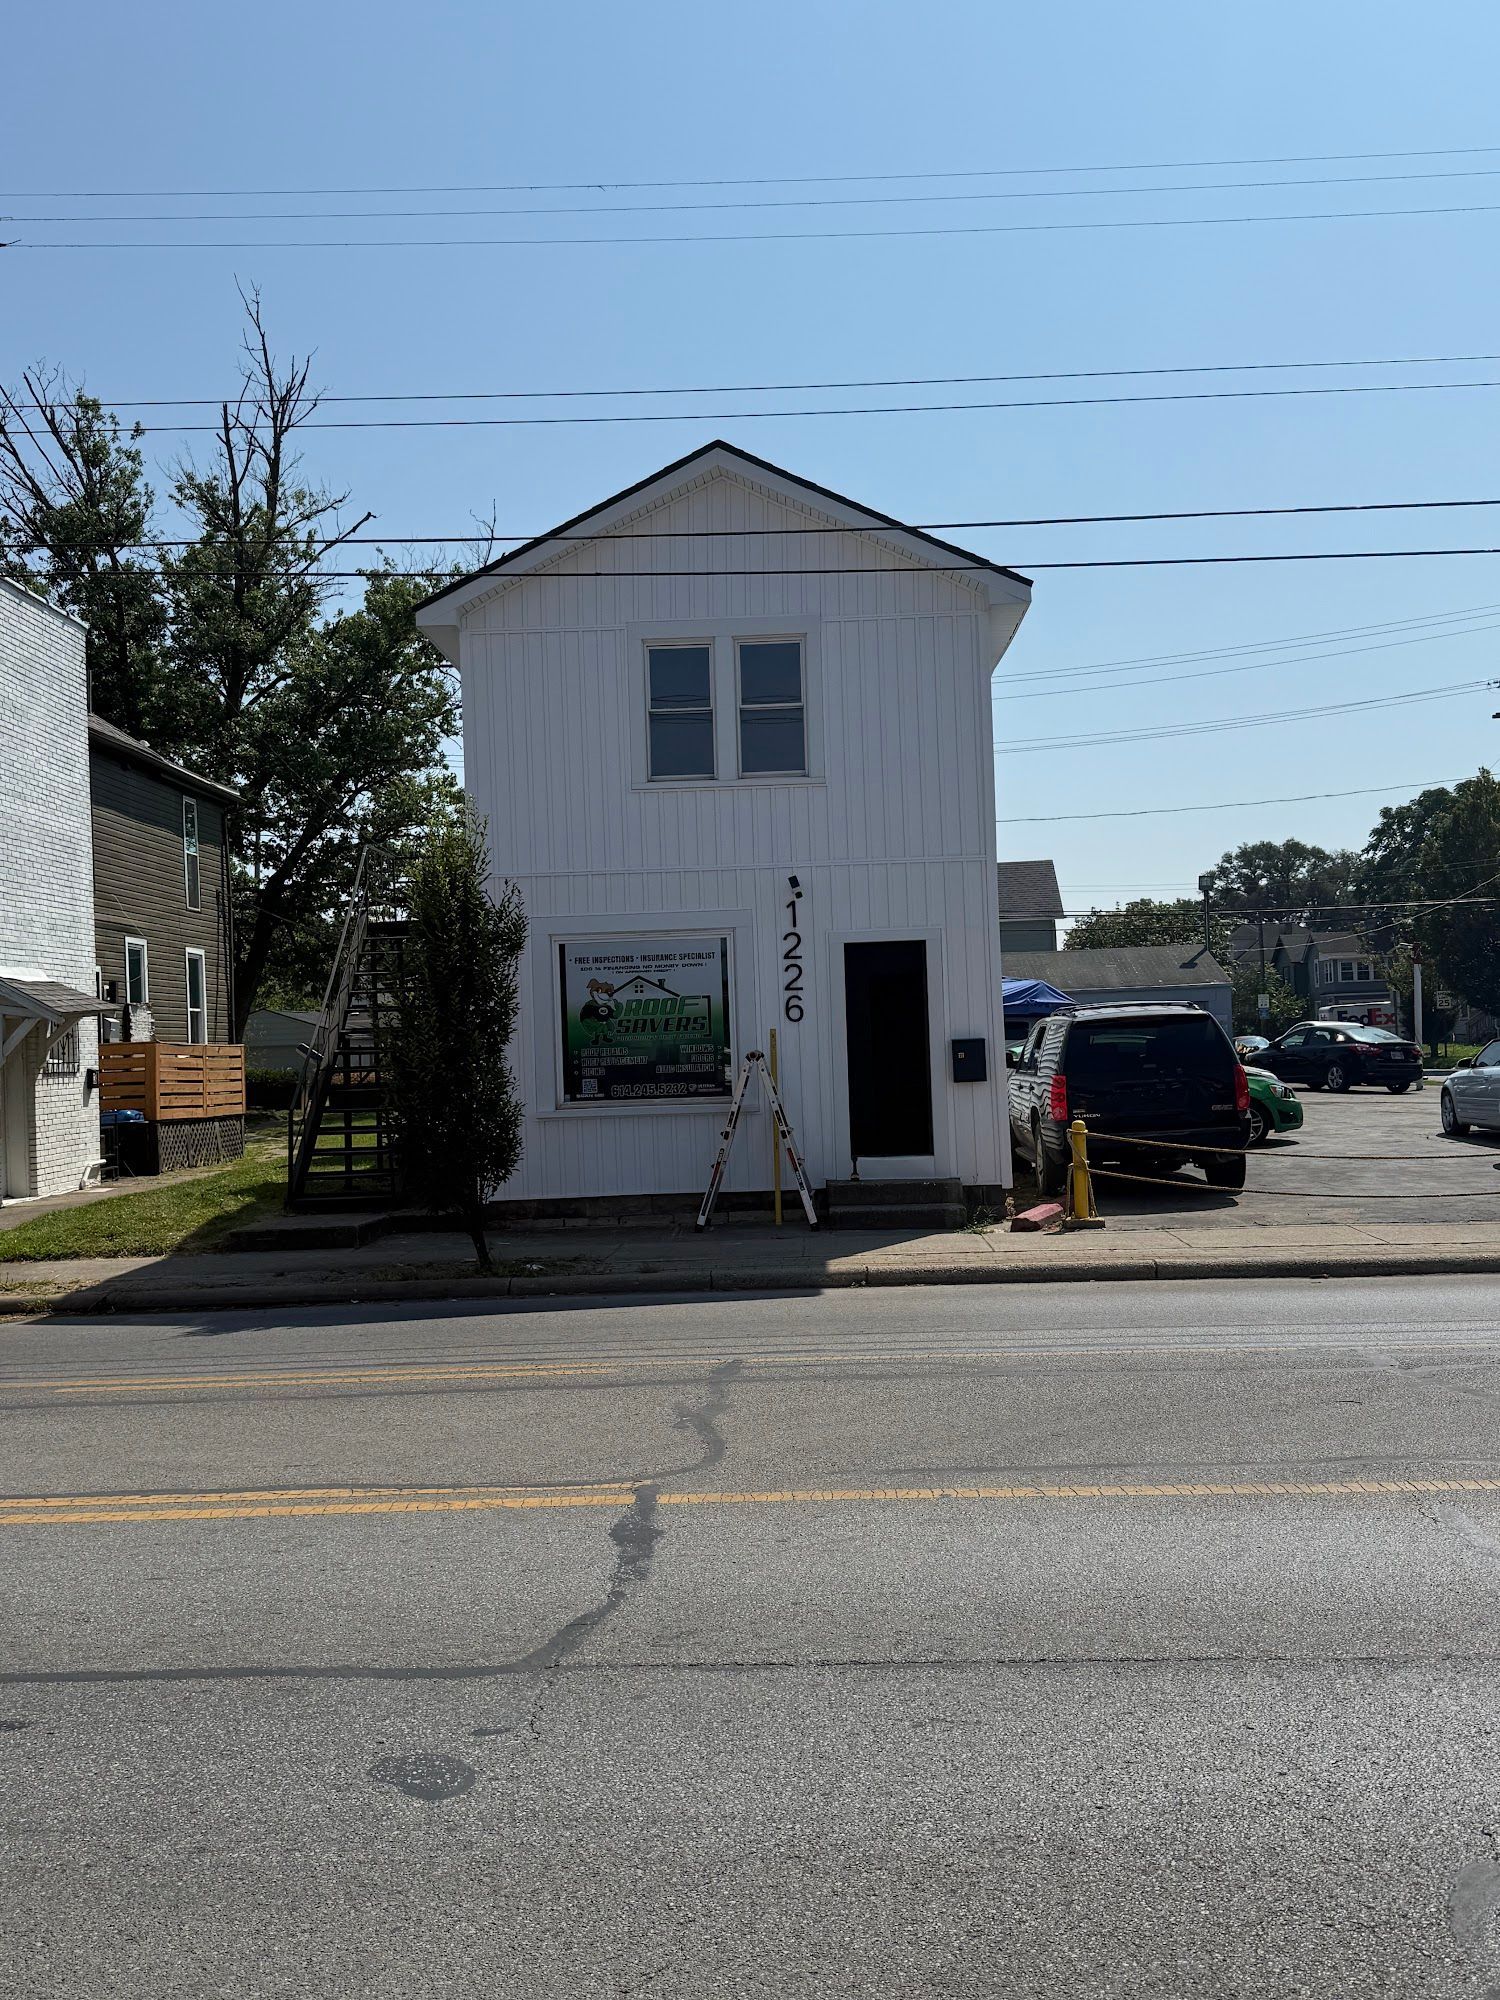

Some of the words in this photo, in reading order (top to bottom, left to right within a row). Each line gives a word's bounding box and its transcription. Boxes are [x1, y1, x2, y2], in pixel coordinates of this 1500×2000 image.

[574, 956, 591, 965] FREE
[592, 955, 634, 964] INSPECTIONS
[640, 953, 678, 962] INSURANCE
[678, 952, 716, 961] SPECIALIST
[782, 900, 804, 1023] 1226
[624, 996, 701, 1017] ROOF
[1438, 999, 1450, 1007] 25
[616, 1016, 707, 1033] SAVERS
[1337, 1008, 1397, 1026] FedEx
[611, 1083, 688, 1098] 614.245.5232
